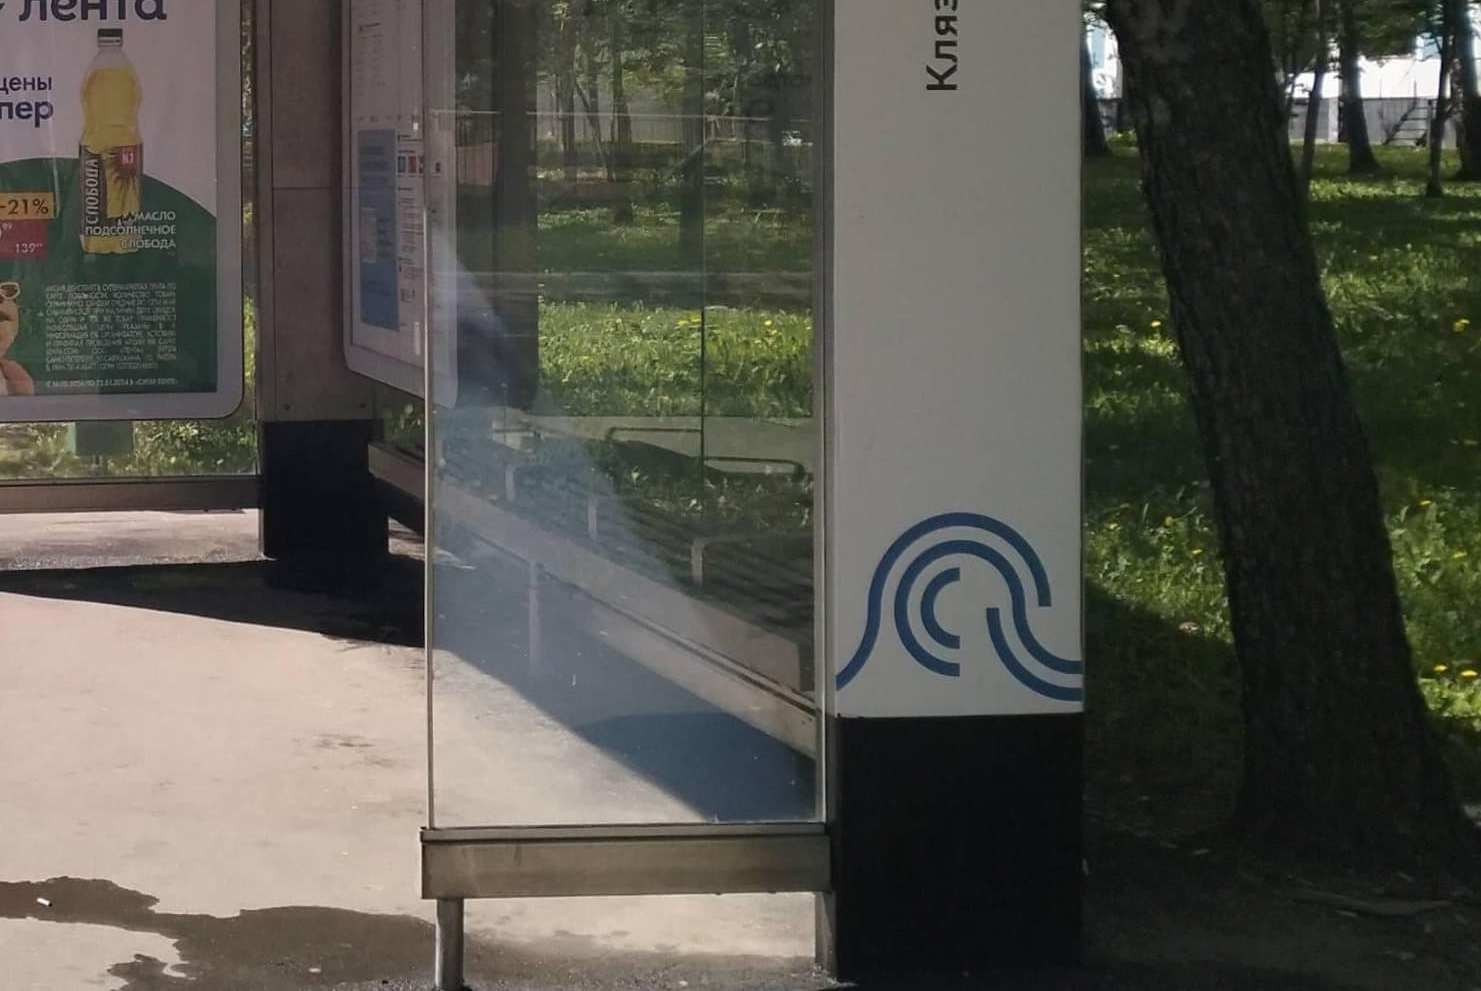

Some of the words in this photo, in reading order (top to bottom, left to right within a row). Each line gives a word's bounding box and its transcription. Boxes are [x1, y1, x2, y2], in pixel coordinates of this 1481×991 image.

[134, 210, 176, 221] МАСЛО
[85, 224, 176, 236] ПОДСОЛНЕЧНОЕ
[121, 238, 177, 250] СЛОБОДА
